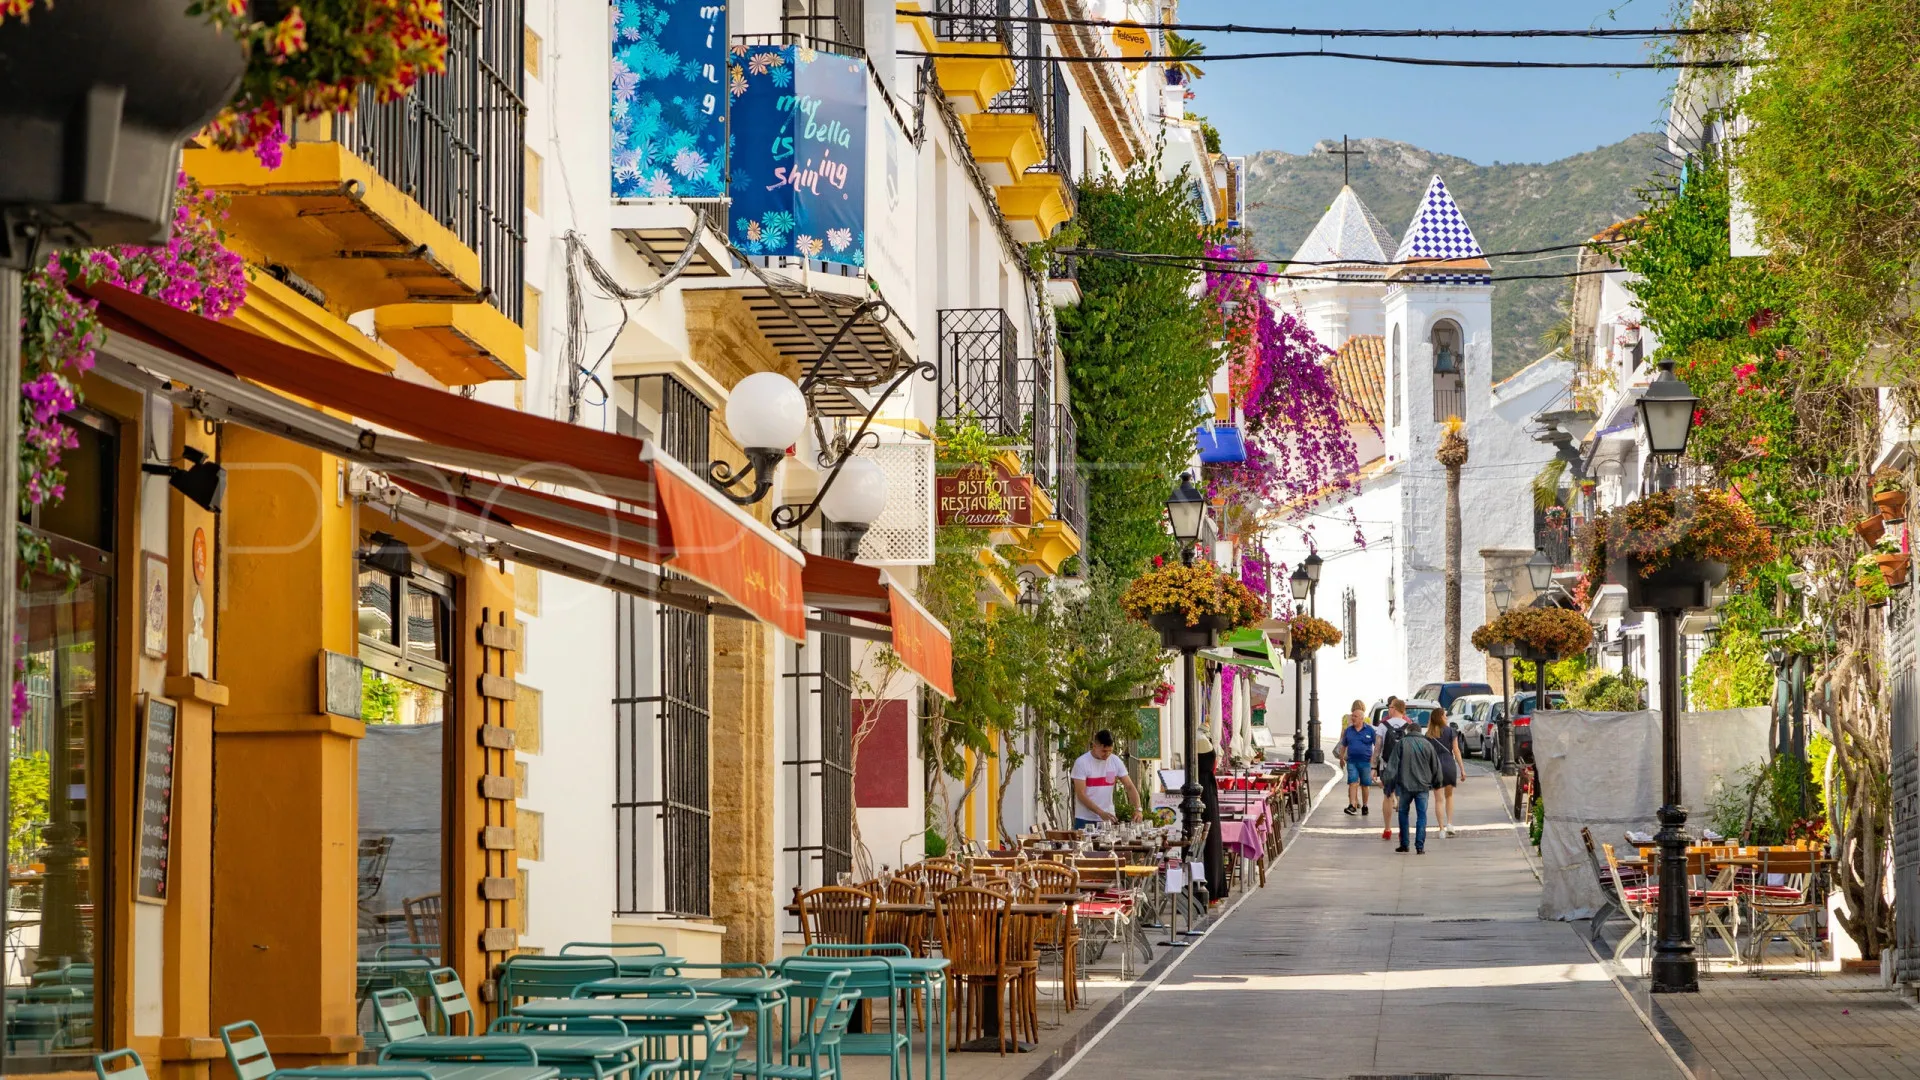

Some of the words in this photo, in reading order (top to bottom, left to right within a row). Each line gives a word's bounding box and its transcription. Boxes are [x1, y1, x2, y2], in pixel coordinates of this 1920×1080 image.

[1116, 29, 1145, 44] Televes
[776, 94, 822, 116] mar
[771, 124, 795, 161] is
[804, 113, 851, 149] bella
